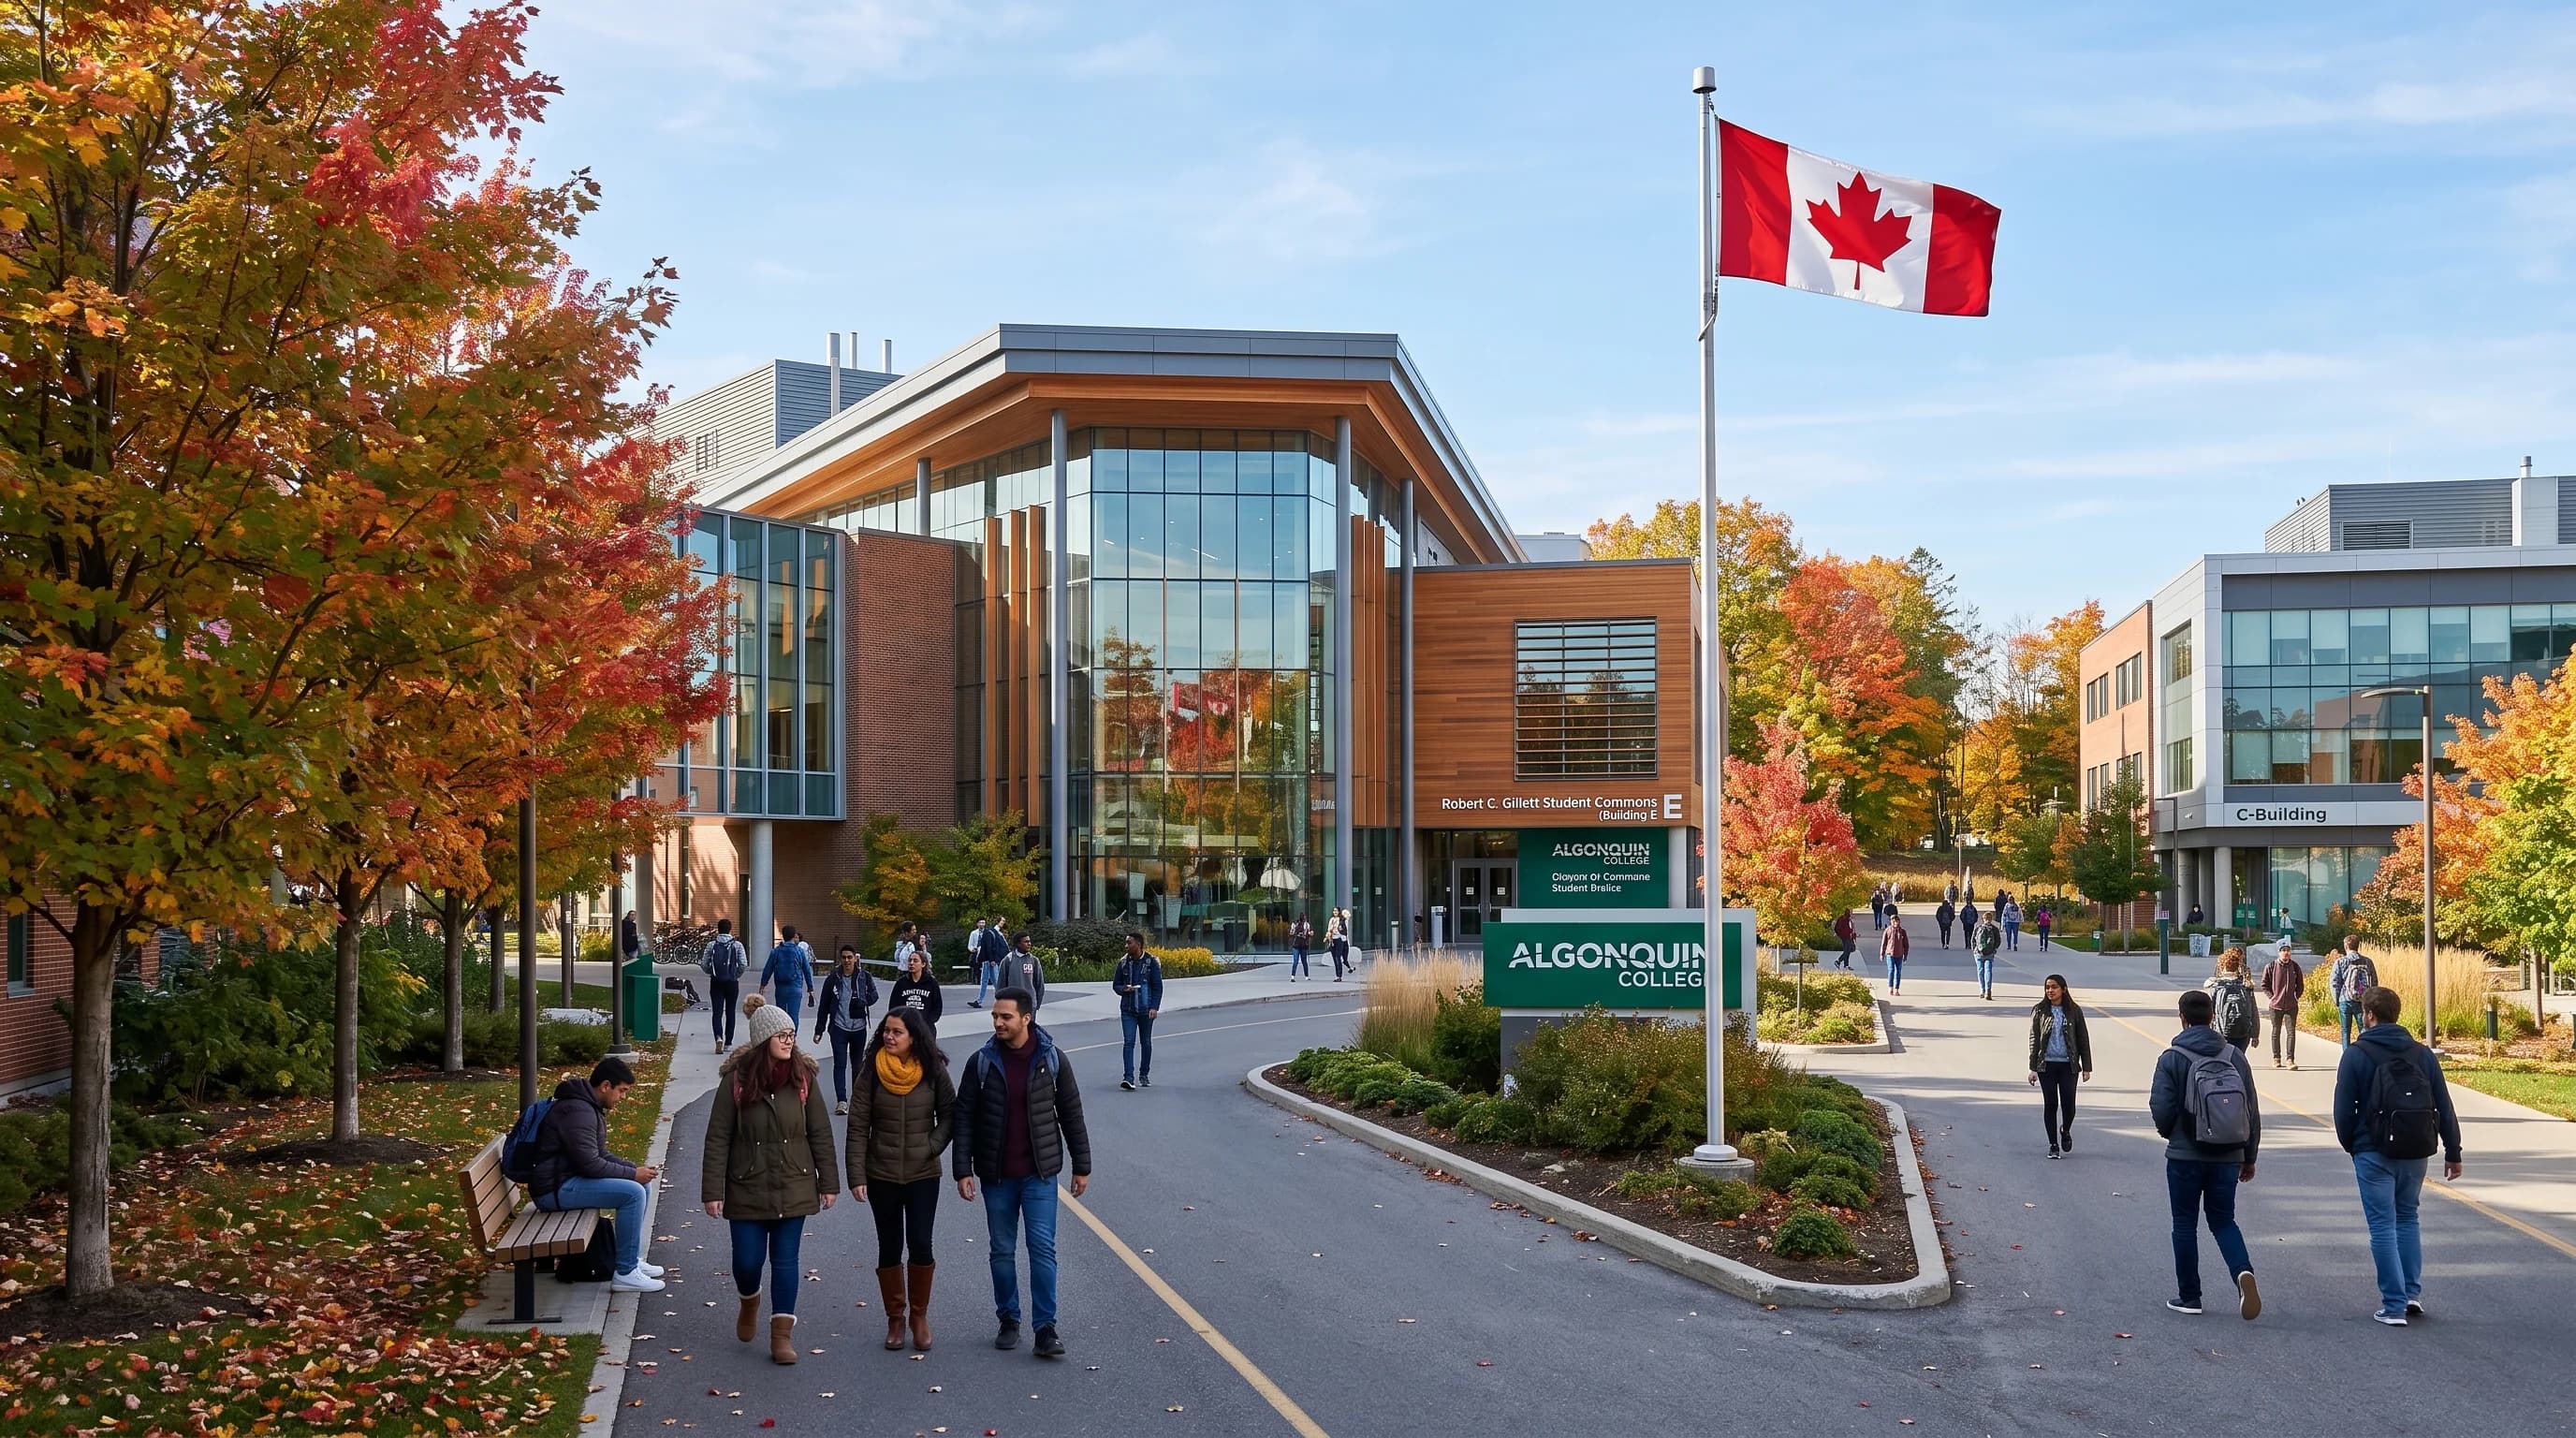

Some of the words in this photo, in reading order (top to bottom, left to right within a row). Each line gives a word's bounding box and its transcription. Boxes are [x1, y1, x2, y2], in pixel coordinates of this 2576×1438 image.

[1442, 798, 1484, 810] Robert
[1486, 798, 1499, 809] C.
[1502, 797, 1540, 809] Gillett
[1543, 797, 1591, 808] Student
[1594, 797, 1658, 808] Commons
[1663, 794, 1683, 819] E
[1599, 810, 1647, 821] (Building
[1650, 810, 1658, 820] E
[2236, 807, 2327, 823] C-Building
[1552, 843, 1650, 857] ALGONQUIN
[1603, 857, 1650, 865] COLLEGE
[1552, 884, 1588, 892] Student
[1508, 942, 1705, 969] ALGONQUIN
[1618, 971, 1705, 988] COLLEG
